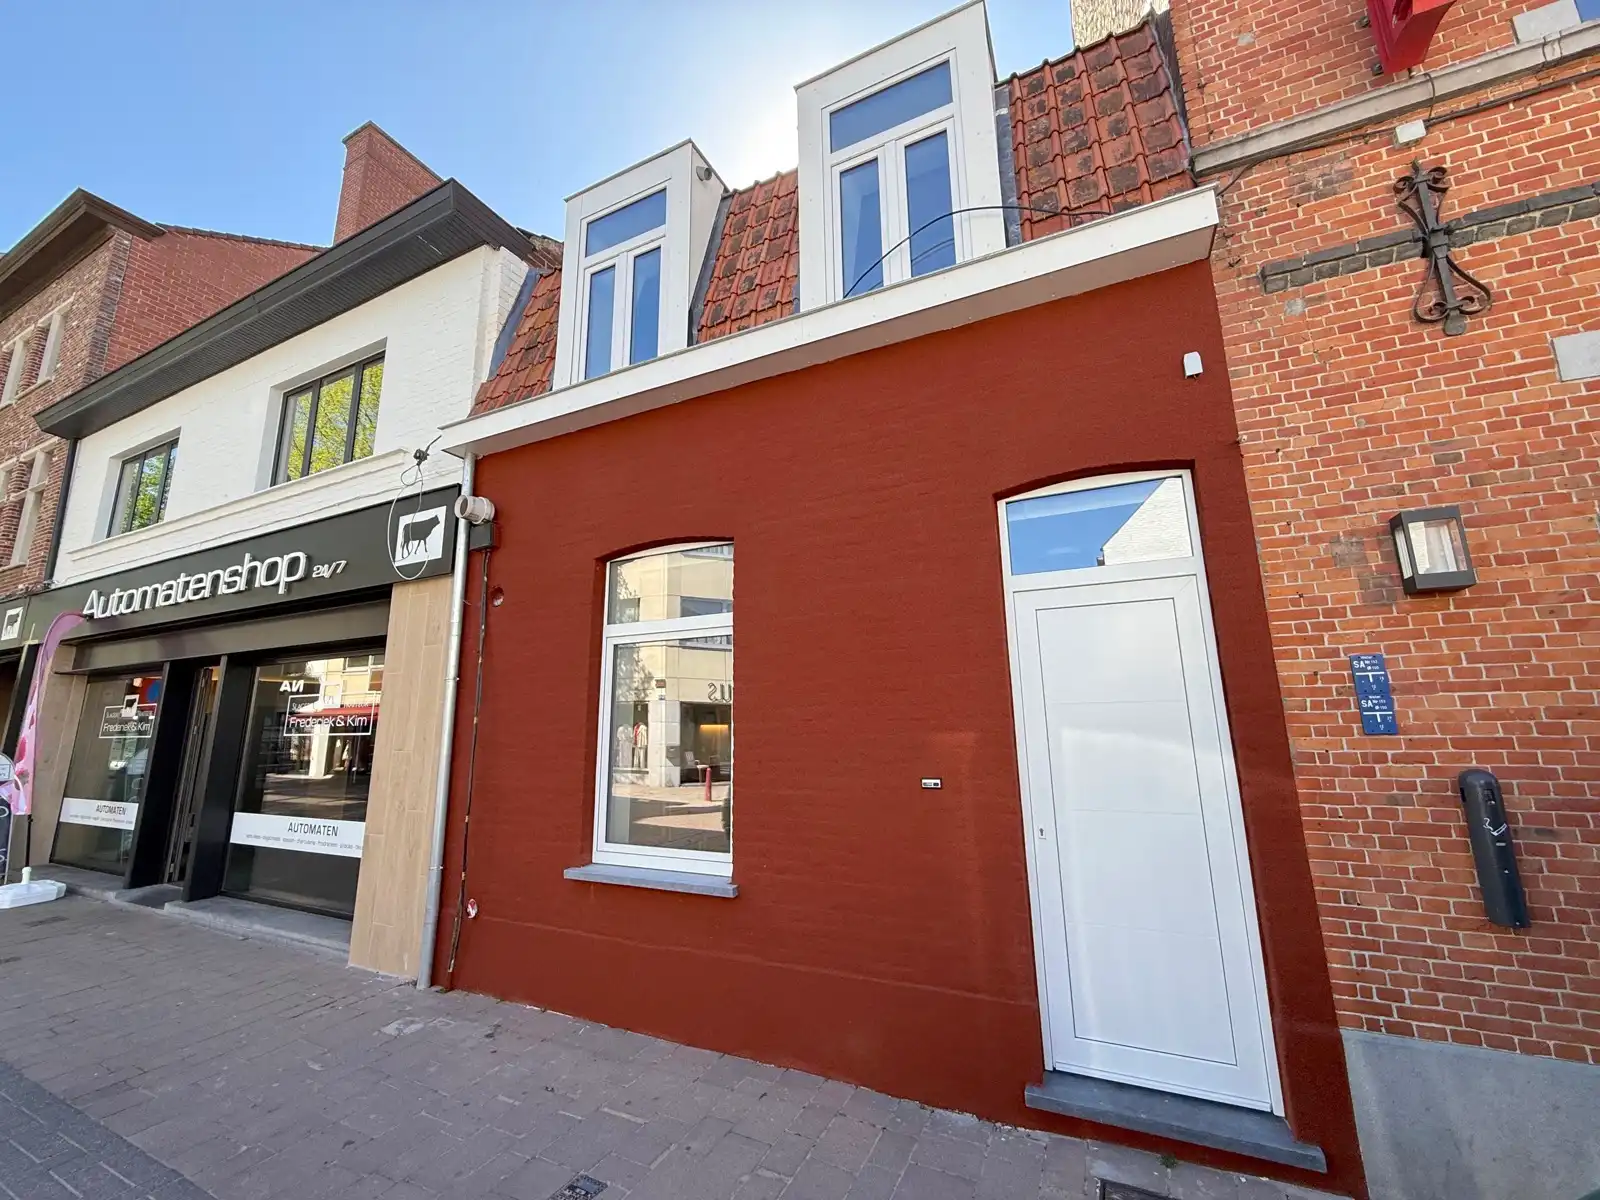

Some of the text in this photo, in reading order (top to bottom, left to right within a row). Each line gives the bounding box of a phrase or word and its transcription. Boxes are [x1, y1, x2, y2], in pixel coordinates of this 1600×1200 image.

[83, 551, 347, 619] Automatenshop 24/7
[1353, 660, 1366, 668] SA
[1361, 699, 1373, 708] SA
[137, 721, 151, 731] Kim
[335, 715, 345, 727] &
[346, 715, 367, 727] Kim
[95, 804, 127, 815] AUTOMATEN
[287, 822, 339, 837] AUTOMATEN
